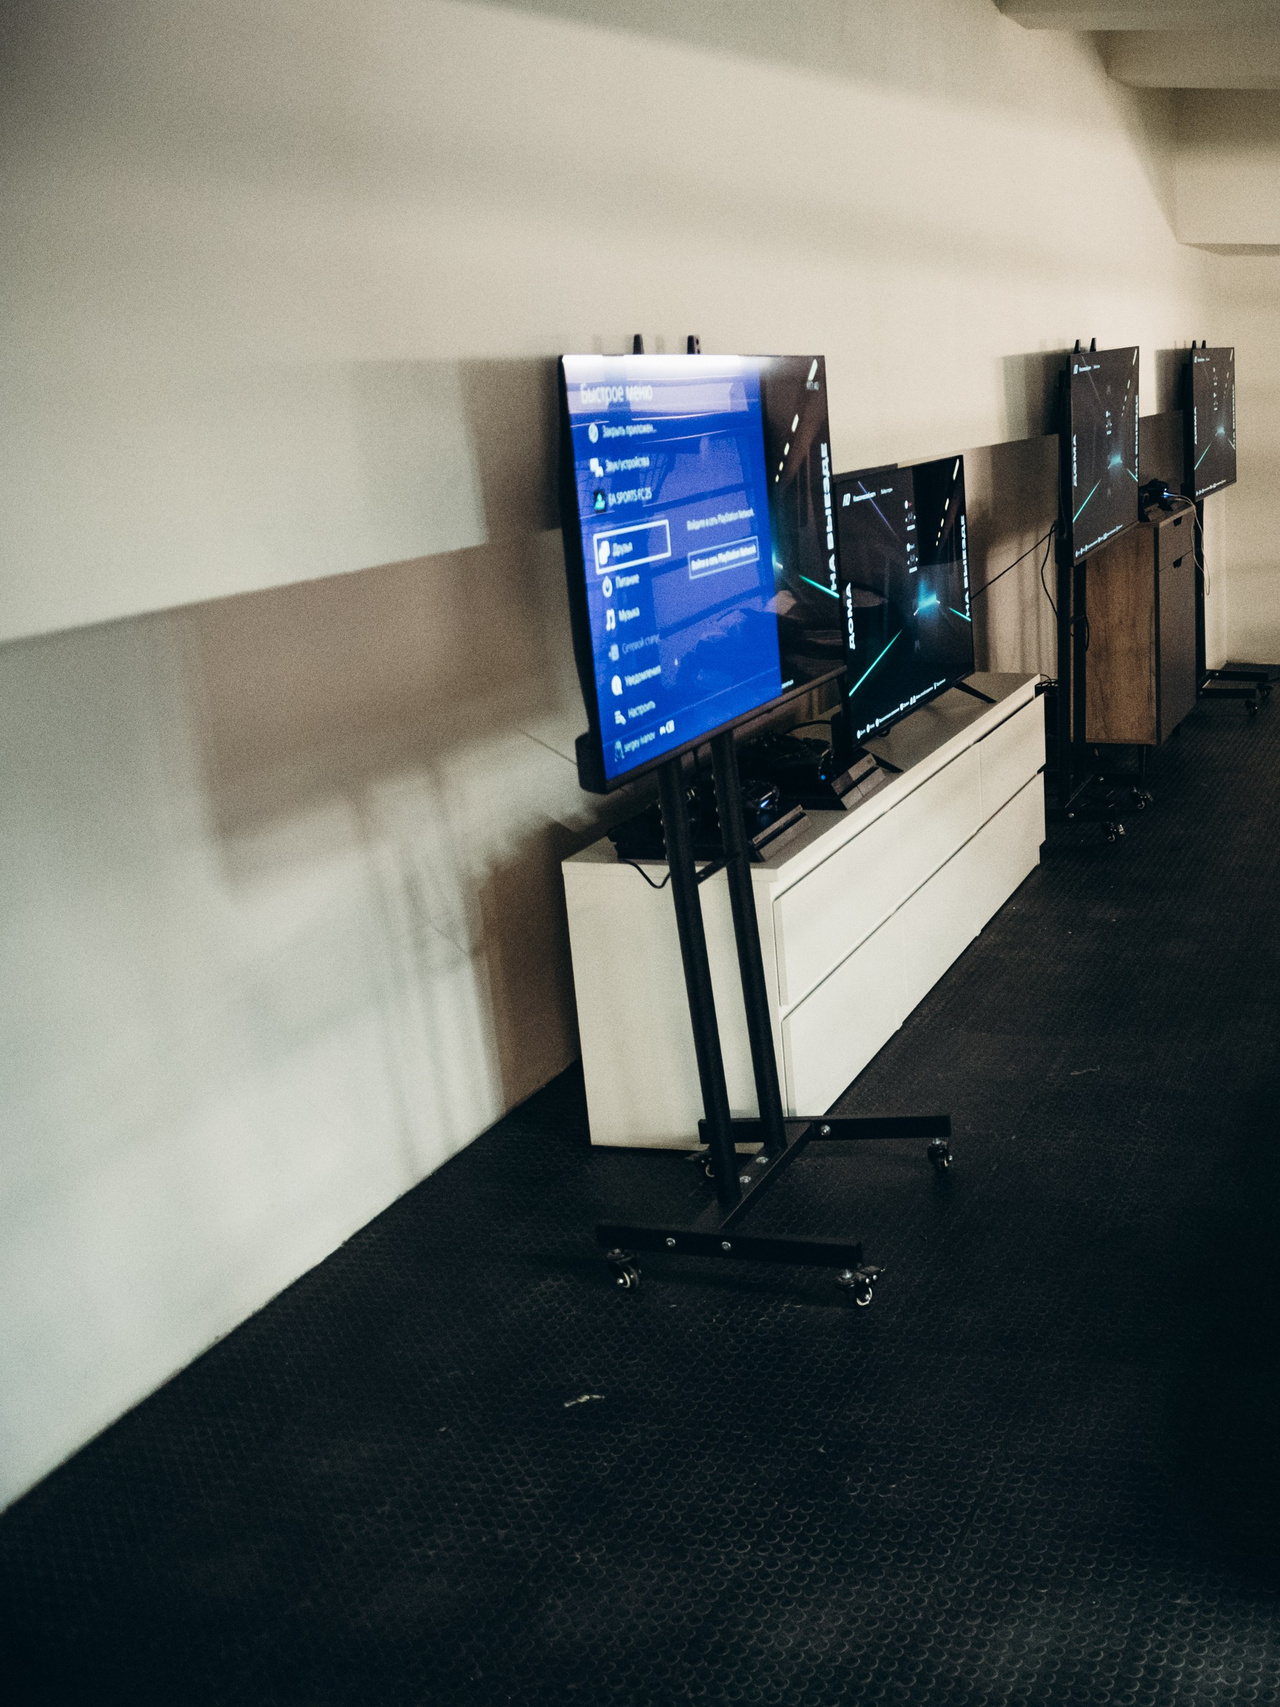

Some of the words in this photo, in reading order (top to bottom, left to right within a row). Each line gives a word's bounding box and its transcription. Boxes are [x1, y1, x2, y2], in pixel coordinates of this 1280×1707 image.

[580, 383, 624, 406] Быстрое
[625, 384, 653, 402] меню
[608, 492, 616, 506] EA
[616, 489, 637, 505] SPORTS
[637, 488, 645, 501] FC
[820, 442, 835, 551] ВЫЕЗДЕ
[612, 542, 633, 557] Друзья
[960, 514, 969, 589] ВЫЕЗДЕ
[615, 573, 640, 589] Питание
[828, 554, 838, 591] НА
[618, 606, 640, 623] Музыка
[964, 591, 970, 617] НА
[845, 582, 856, 650] ДОМА
[624, 665, 662, 687] Уведомления
